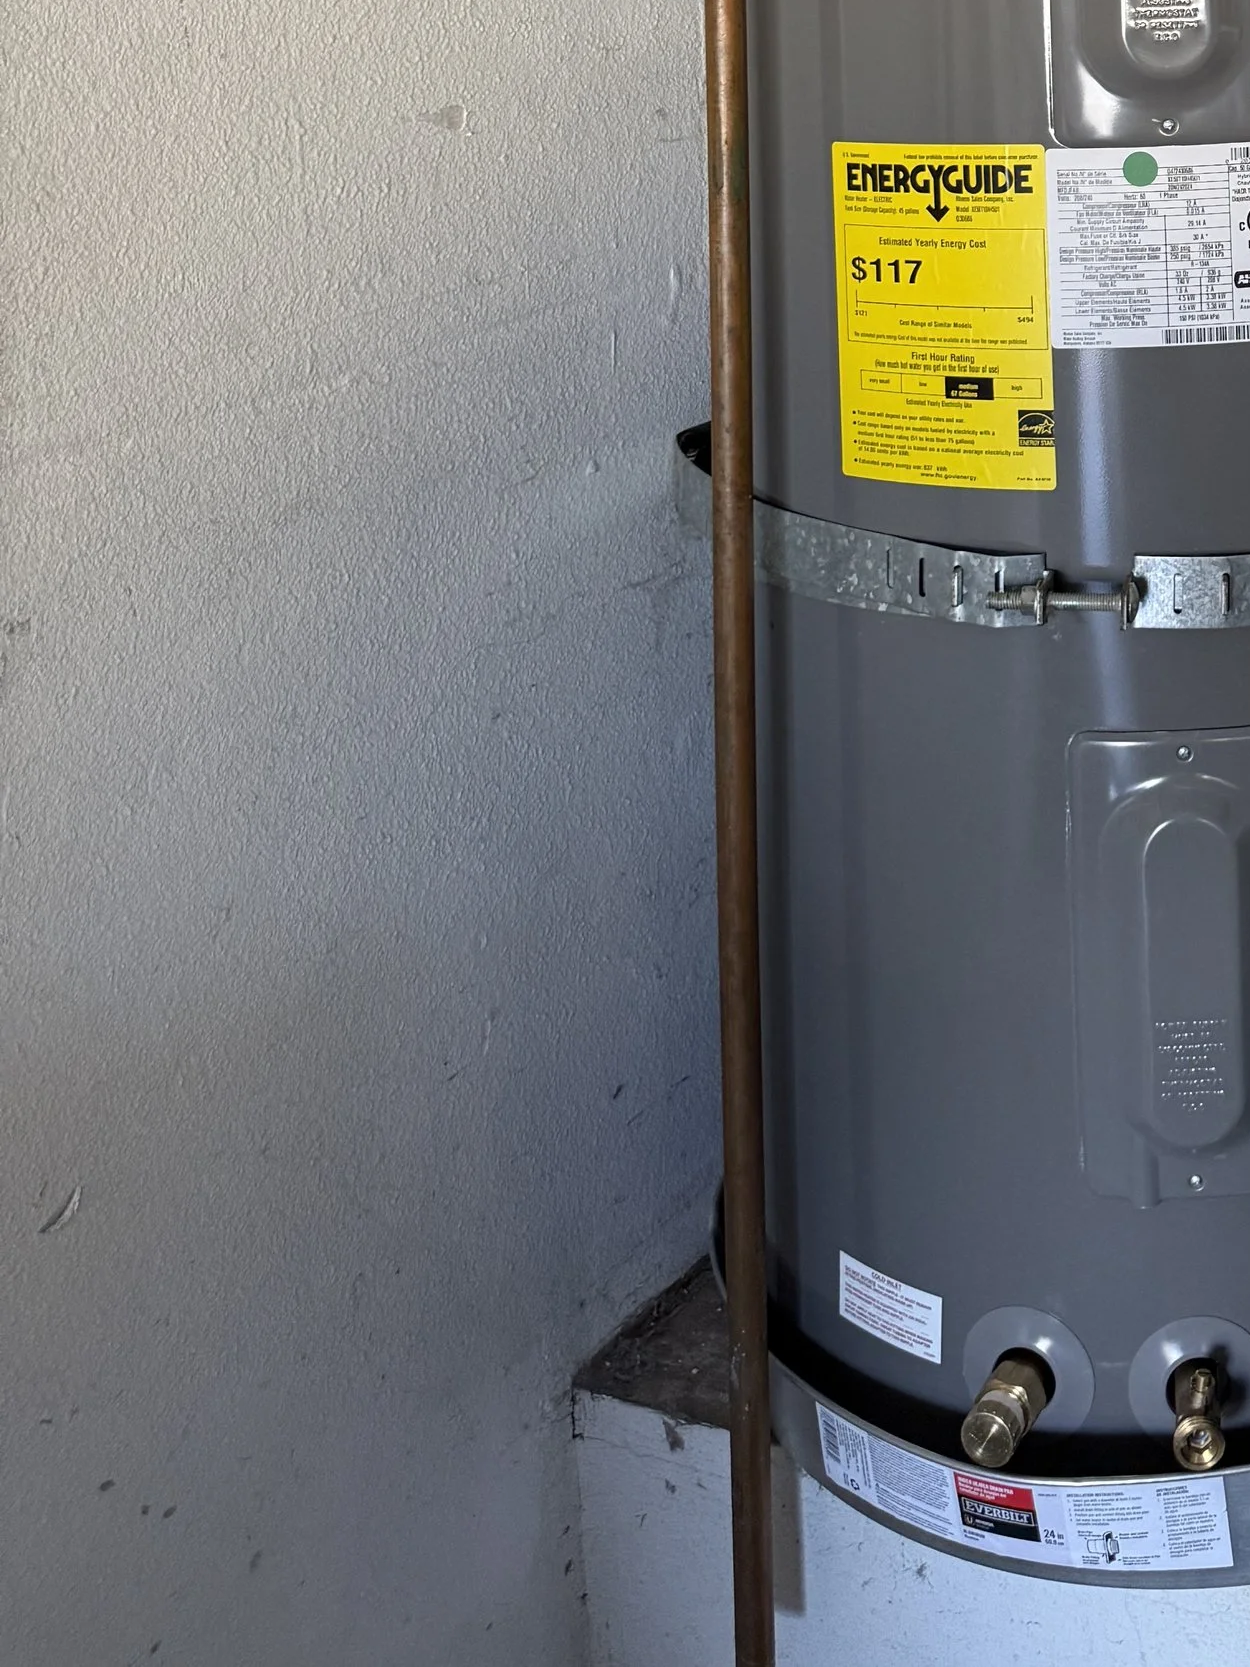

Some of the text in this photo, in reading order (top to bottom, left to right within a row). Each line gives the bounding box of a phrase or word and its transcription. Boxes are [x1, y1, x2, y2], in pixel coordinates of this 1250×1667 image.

[846, 163, 1033, 194] ENERGYGUIDE
[1239, 221, 1245, 231] C
[879, 237, 986, 250] Estimated Yearly Energy Cost
[851, 256, 922, 285] $117
[911, 320, 926, 328] Range
[911, 352, 975, 364] First Hour Rating
[965, 1500, 1030, 1524] EVERBILT
[1043, 1529, 1056, 1539] 24
